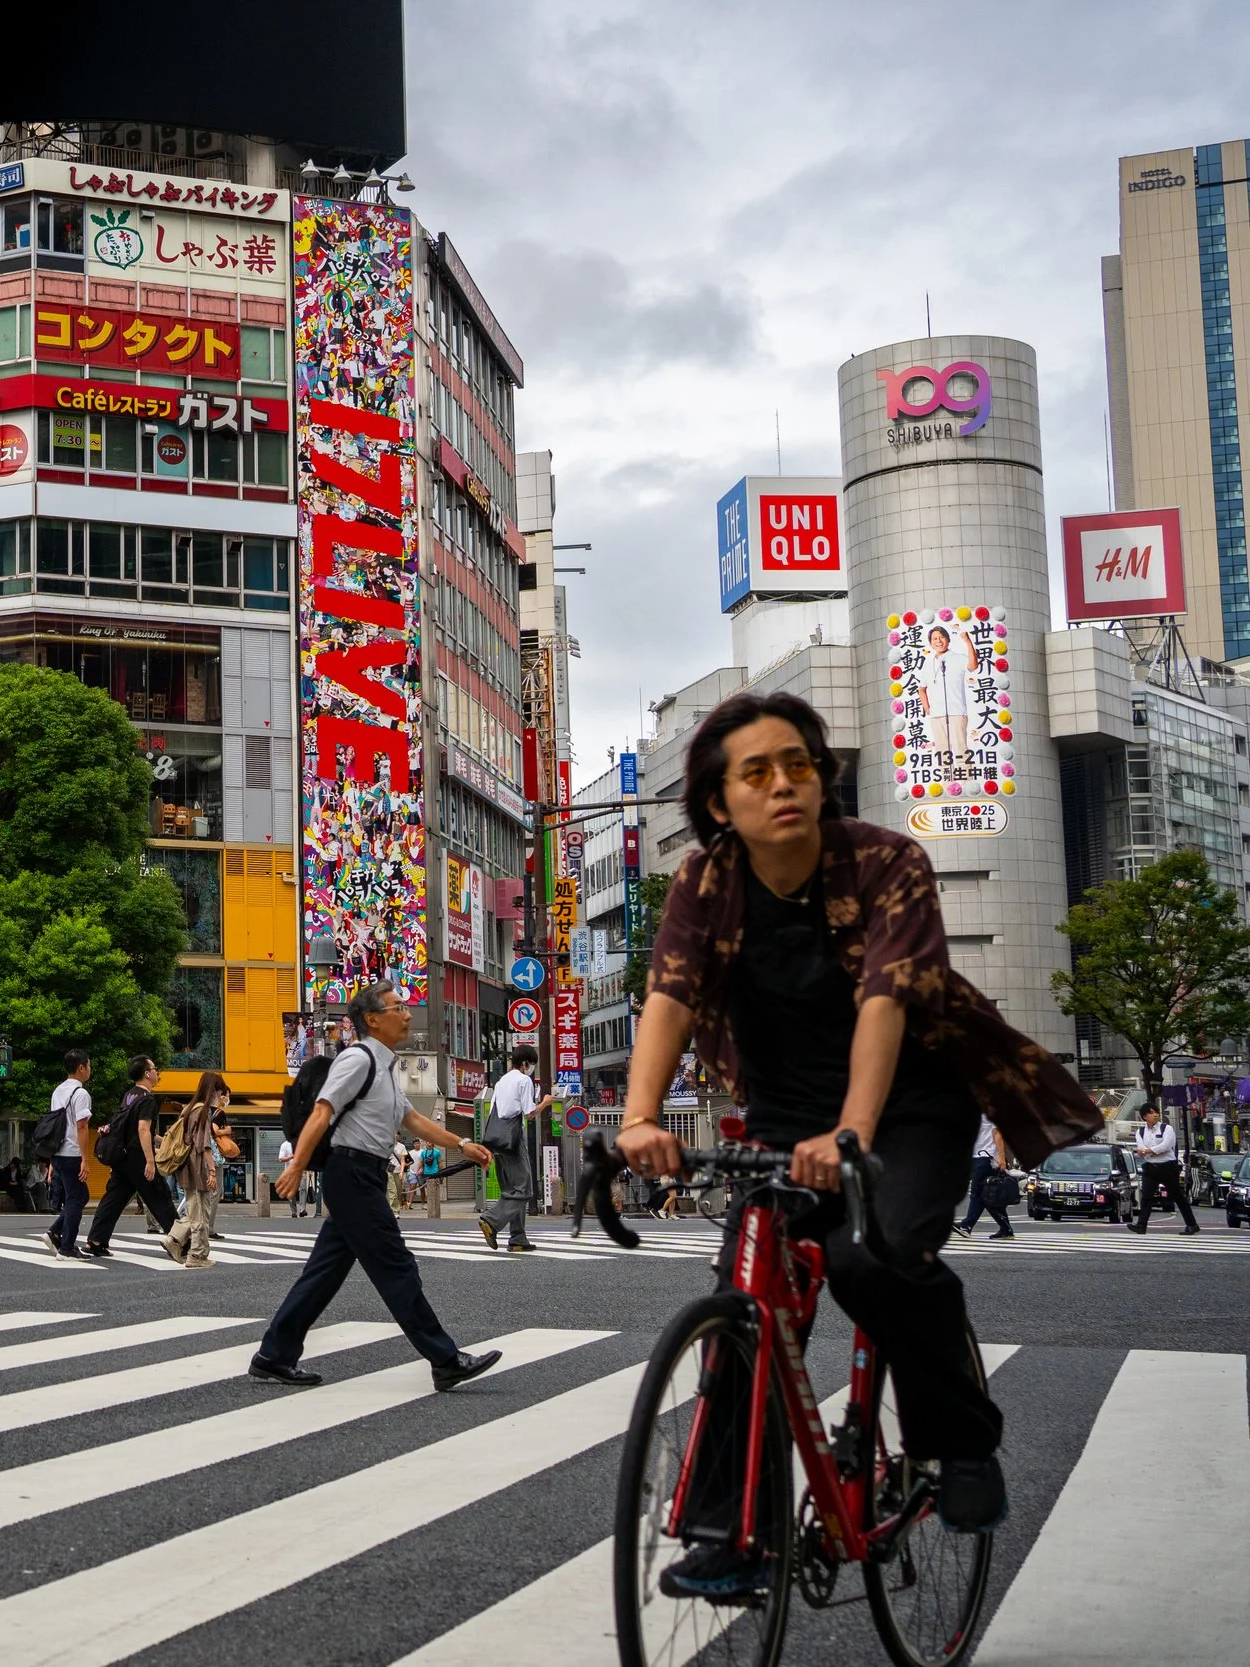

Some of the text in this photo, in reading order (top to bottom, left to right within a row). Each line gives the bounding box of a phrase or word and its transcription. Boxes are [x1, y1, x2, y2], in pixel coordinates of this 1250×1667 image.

[69, 165, 279, 214] しゃぶしゃぶバイキング
[1128, 175, 1186, 193] INDIGO
[155, 224, 277, 275] しゃぶ葉
[37, 311, 234, 365] コンタクト
[177, 392, 268, 433] ガスト
[877, 361, 991, 436] 109
[55, 418, 83, 430] OPEN
[887, 422, 953, 444] SHIBUYA
[724, 499, 741, 547] THE
[769, 505, 824, 530] UNI
[721, 539, 748, 596] PRIME
[770, 536, 830, 566] QLO
[1094, 545, 1153, 583] H&M
[900, 625, 930, 751] 運動会開幕
[970, 621, 1002, 748] 世界最大の
[910, 749, 997, 769] 9月13-21日
[941, 817, 996, 832] 世界陸上
[555, 881, 574, 952] 処方せん
[578, 931, 589, 974] 渋谷駅前
[557, 992, 578, 1068] スギ薬局
